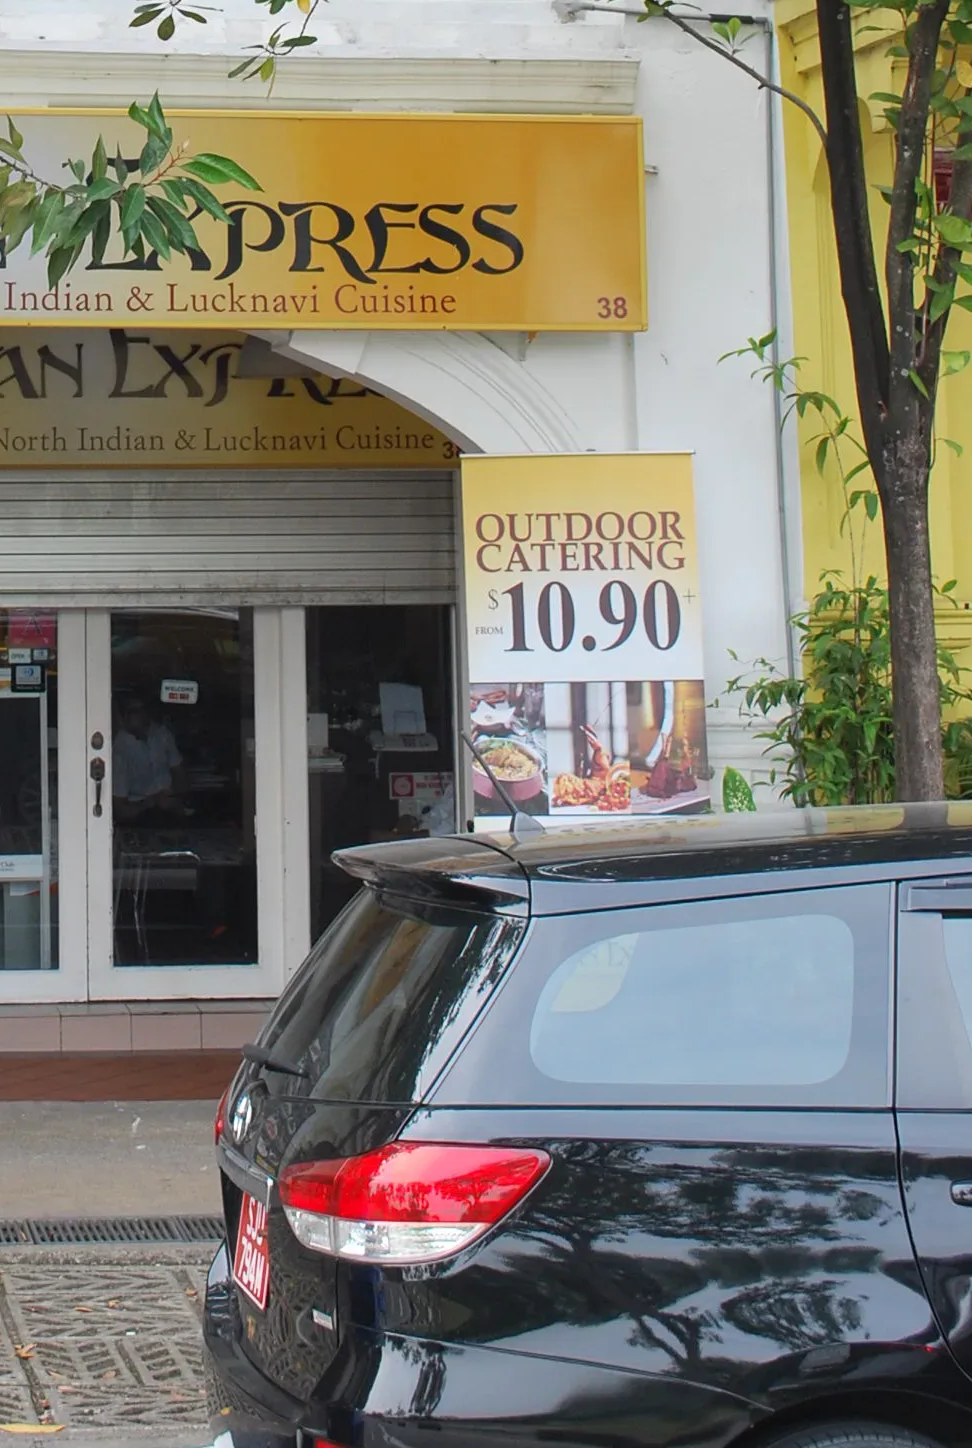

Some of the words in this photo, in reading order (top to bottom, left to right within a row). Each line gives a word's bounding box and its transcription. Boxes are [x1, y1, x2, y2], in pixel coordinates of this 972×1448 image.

[4, 281, 114, 313] Indian
[127, 284, 155, 313] &
[167, 282, 321, 314] Lucknavi
[334, 283, 457, 315] Cuisine
[597, 296, 629, 319] 38
[77, 426, 165, 452] Indian
[174, 427, 197, 452] &
[204, 426, 327, 452] Lucknavi
[336, 425, 435, 451] Cuisine
[475, 510, 686, 543] OUTDOOR
[475, 540, 686, 573] CATERING
[475, 626, 504, 636] FROM
